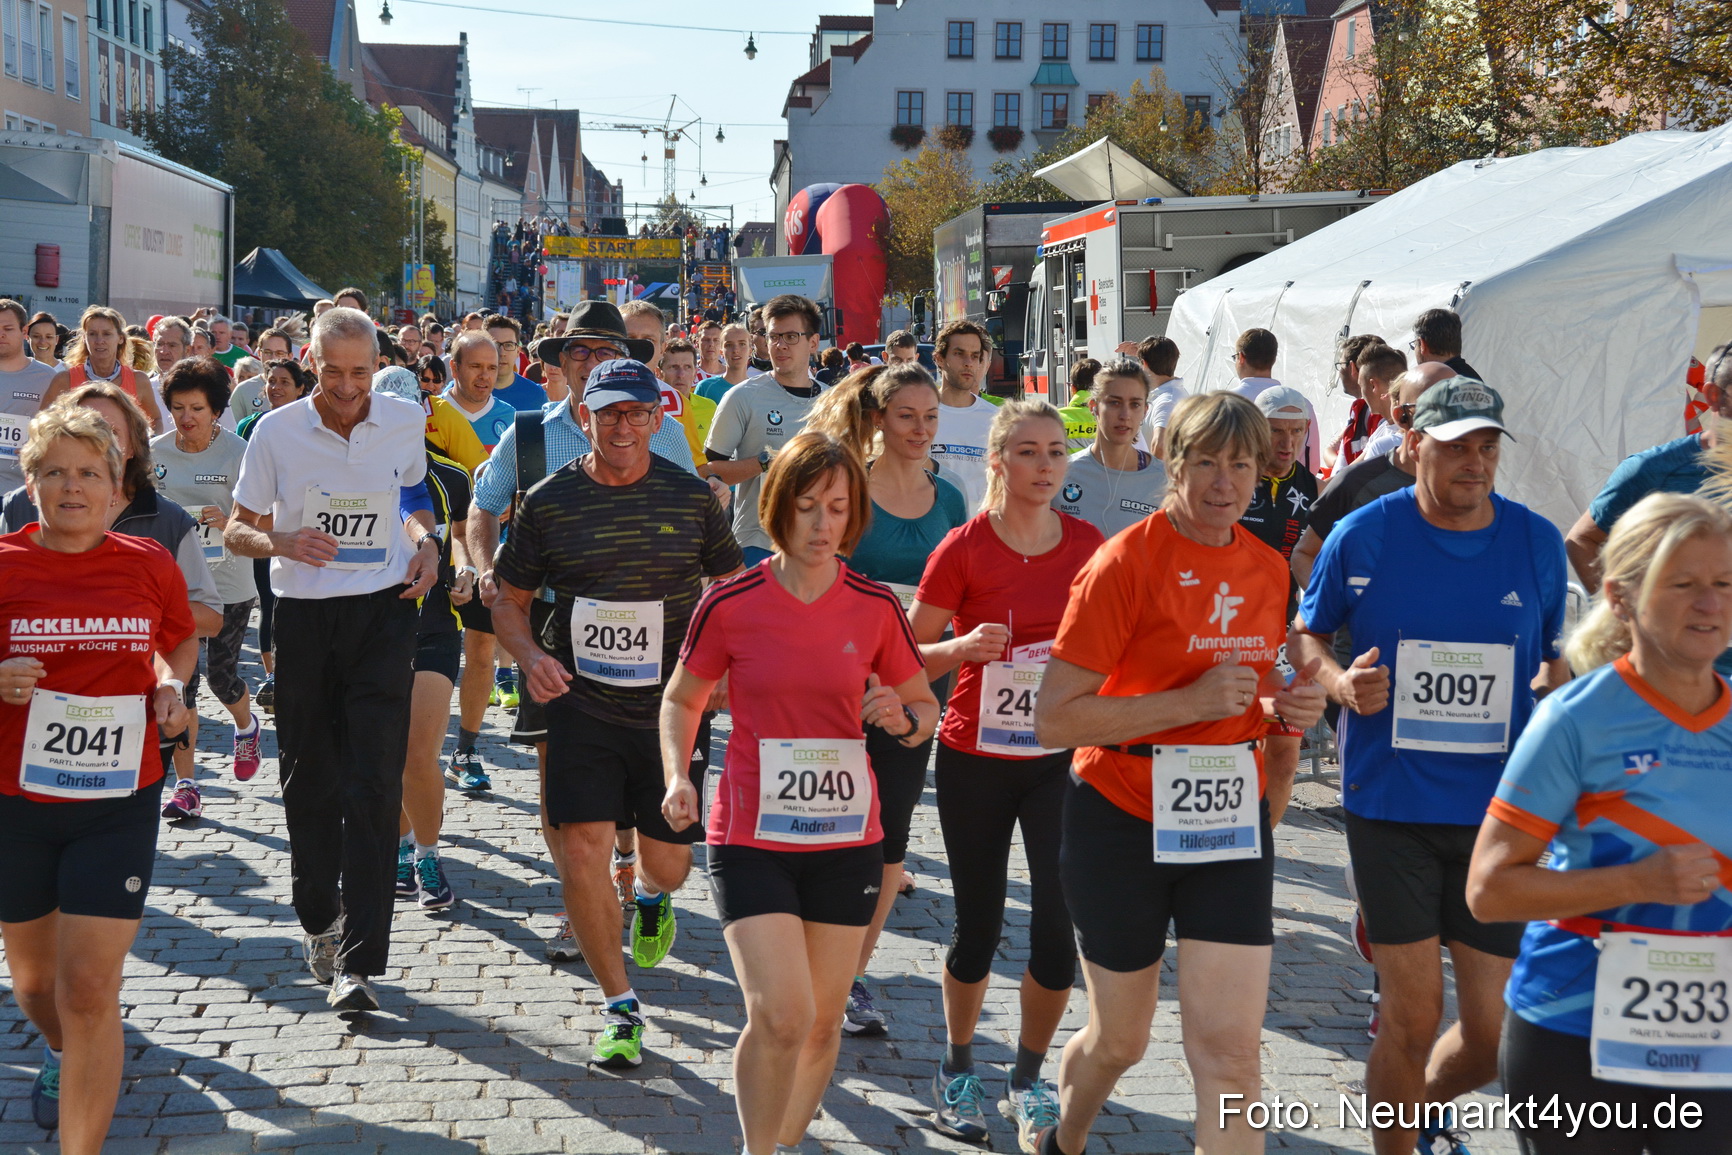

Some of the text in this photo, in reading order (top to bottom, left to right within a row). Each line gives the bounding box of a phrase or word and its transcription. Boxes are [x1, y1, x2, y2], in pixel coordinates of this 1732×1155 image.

[123, 223, 183, 257] OFFICE INDUSTRY LOUNGE
[193, 226, 224, 280] BOCK
[588, 241, 637, 254] START
[763, 278, 807, 288] BOCK
[45, 295, 57, 303] NM
[1099, 296, 1107, 307] Rotes
[13, 391, 40, 401] BOCK
[1451, 390, 1491, 405] KINGS
[195, 475, 227, 483] BOCK
[330, 498, 367, 508] BOCK
[1060, 504, 1081, 512] PARTL
[1120, 499, 1159, 515] BOCK
[316, 512, 378, 537] 3077
[1501, 599, 1523, 607] adidas
[597, 608, 636, 620] BOCK
[10, 617, 150, 634] FACKELMANN
[584, 624, 649, 651] 2034
[1186, 634, 1265, 653] funrunners
[10, 640, 149, 654] HAUSHALT KÜCHE BAD
[589, 651, 608, 660] PARTL
[1213, 647, 1275, 663] nemarkt
[1431, 651, 1484, 665] BOCK
[597, 664, 636, 678] Johann
[1413, 671, 1496, 706] 3097
[66, 704, 115, 719] BOCK
[1419, 708, 1481, 718] PARTL Neumarkt
[43, 722, 124, 756] 2041
[1008, 733, 1039, 745] Anni
[794, 749, 840, 761] BOCK
[1189, 756, 1236, 768] BOCK
[49, 757, 109, 768] PARTL Neumarkt
[56, 772, 106, 787] Christa
[777, 770, 855, 802] 2040
[1171, 777, 1244, 813] 2553
[783, 805, 840, 813] PARTL Neumarkt
[790, 818, 836, 834] Andrea
[1204, 816, 1229, 825] Neumarkt
[1179, 831, 1236, 850] Hildegard
[1648, 949, 1715, 967] BOCK
[1621, 976, 1730, 1024] 2333
[1629, 1027, 1708, 1040] PARTL Neumarkt
[1645, 1049, 1700, 1071] Conny
